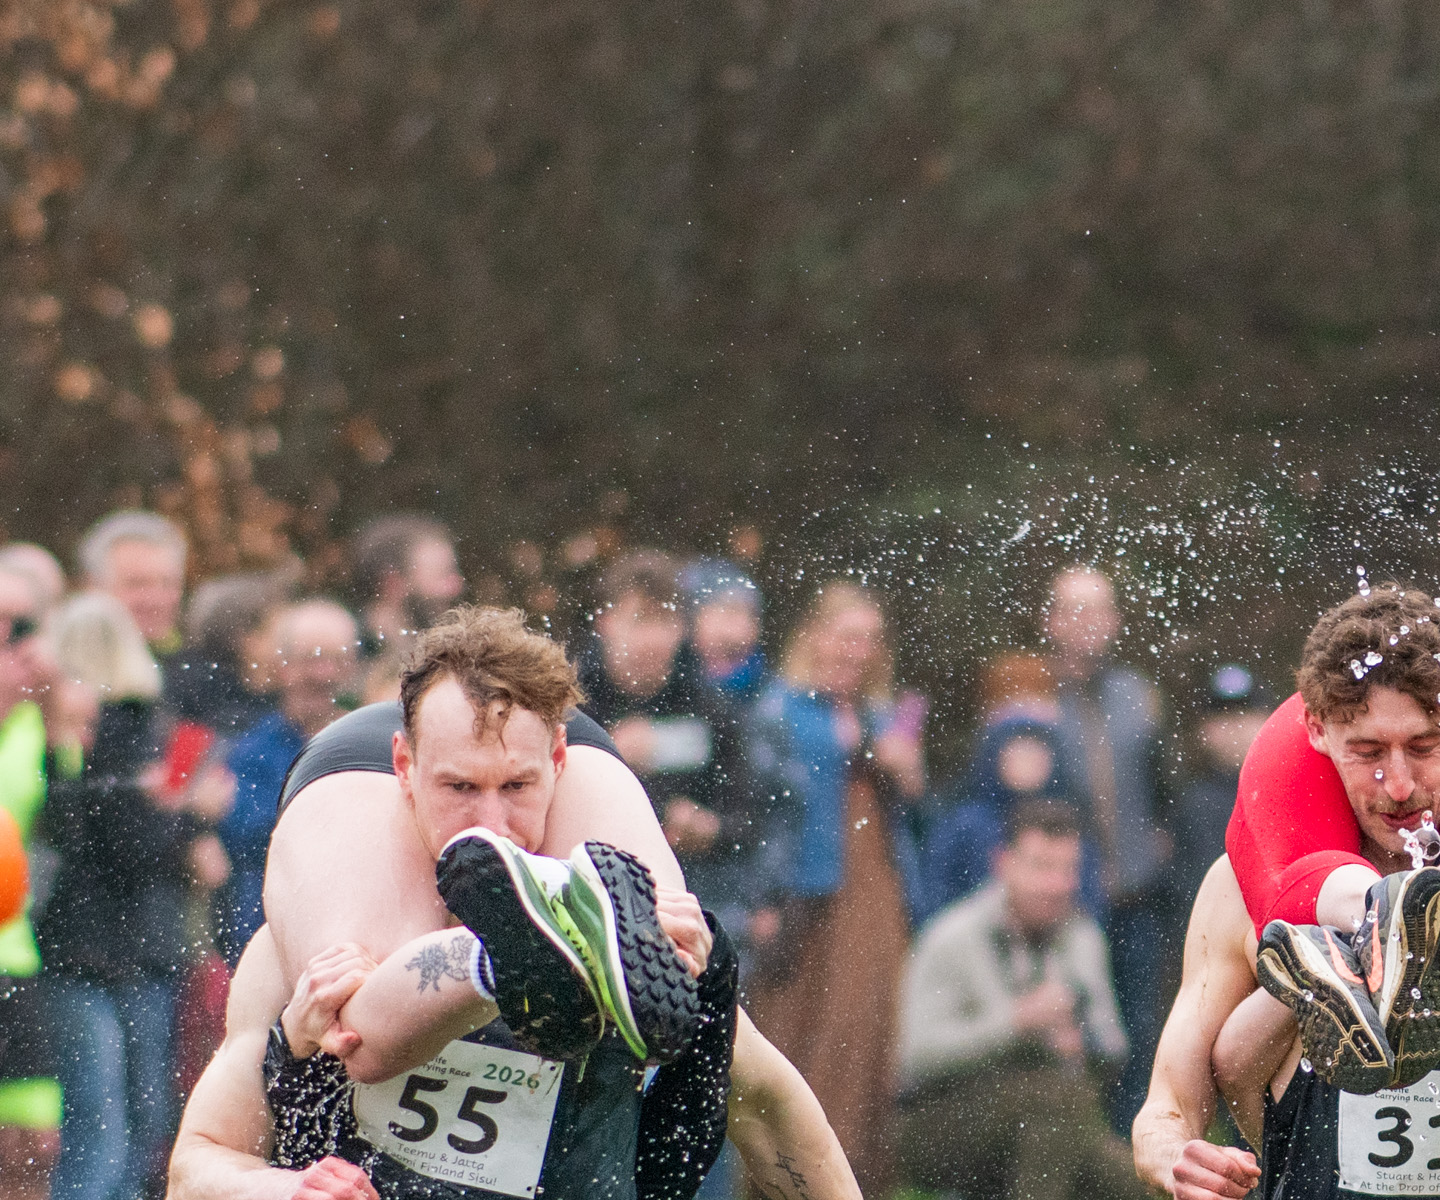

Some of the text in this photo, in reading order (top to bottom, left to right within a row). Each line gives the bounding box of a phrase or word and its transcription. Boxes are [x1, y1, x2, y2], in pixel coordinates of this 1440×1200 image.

[449, 1067, 471, 1078] Race
[483, 1063, 540, 1090] 2026
[1374, 1091, 1434, 1103] Carrying Race
[388, 1073, 508, 1155] 55
[396, 1142, 436, 1160] Teemu
[440, 1153, 448, 1162] &
[420, 1161, 465, 1179] Finland
[469, 1172, 497, 1186] Sisu!
[1376, 1171, 1413, 1181] Stuart
[1417, 1172, 1425, 1181] &
[1360, 1180, 1371, 1190] At
[1376, 1182, 1395, 1192] the
[1398, 1183, 1425, 1194] Drop
[1429, 1182, 1440, 1192] of
